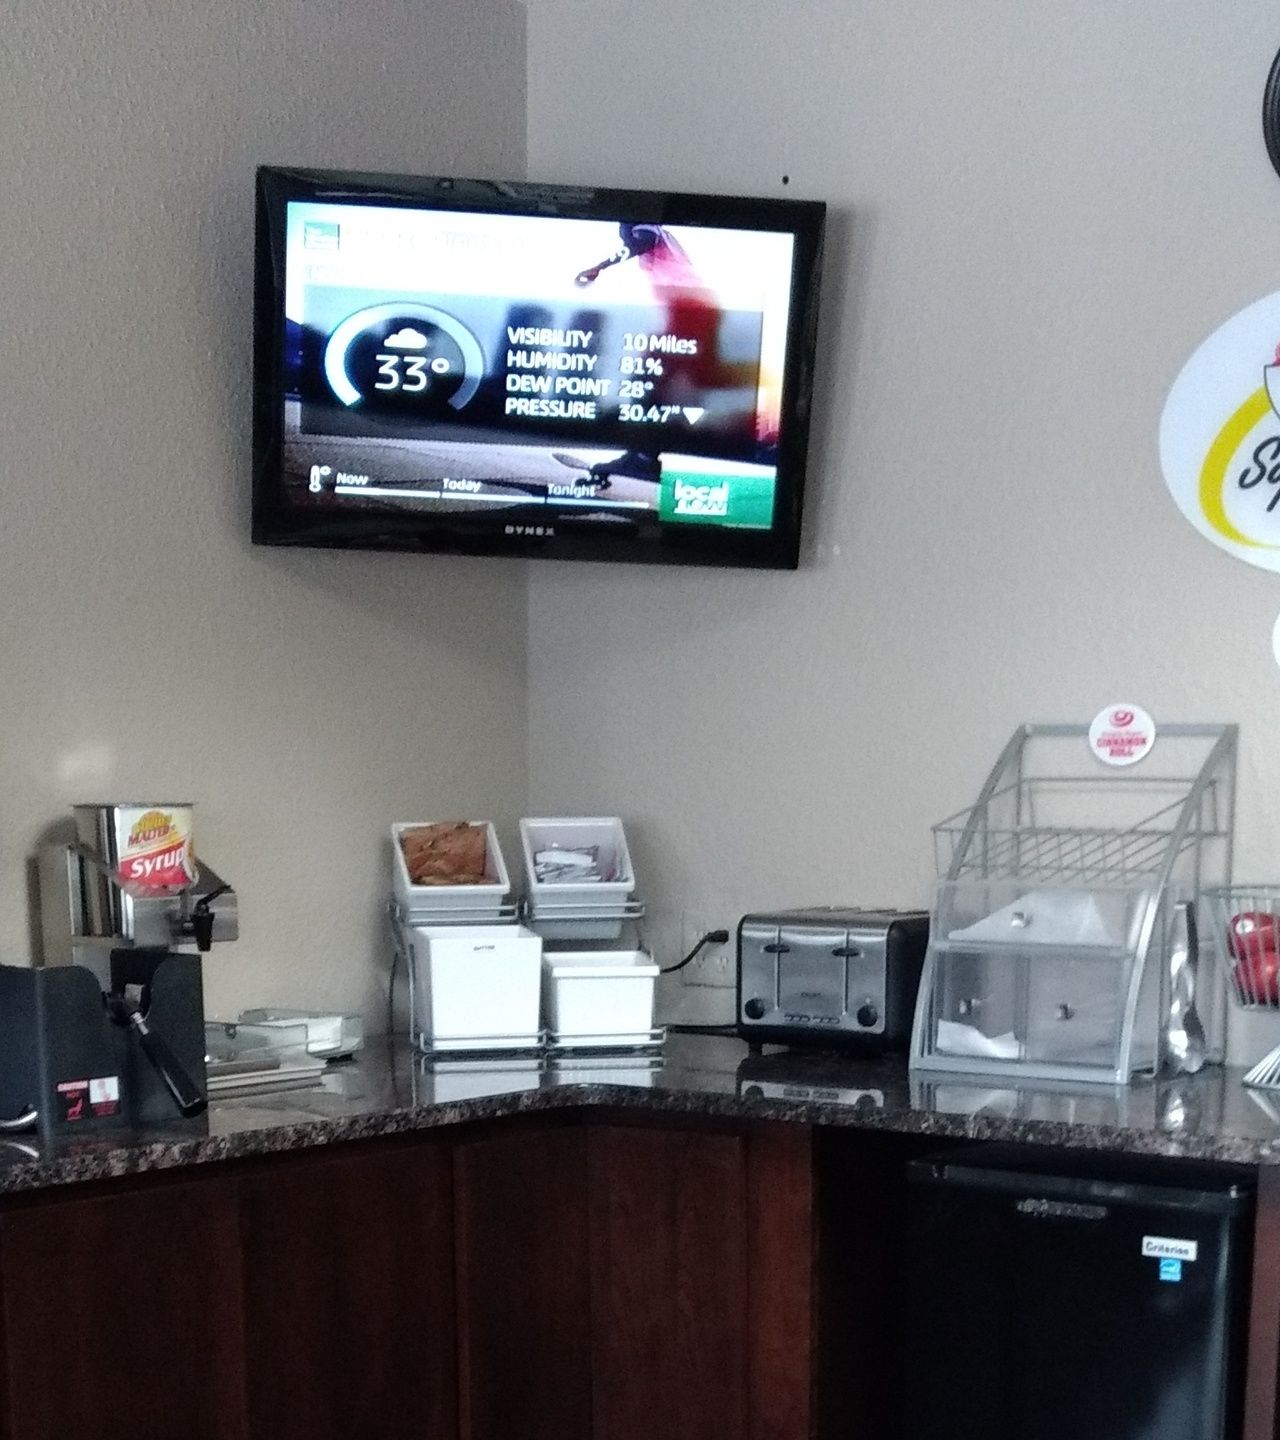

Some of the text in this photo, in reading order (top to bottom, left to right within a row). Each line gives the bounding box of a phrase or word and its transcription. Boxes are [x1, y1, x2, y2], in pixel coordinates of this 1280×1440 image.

[507, 326, 698, 355] VISIBILITY 10 Miles
[507, 350, 664, 376] HUMIDITY 81%
[506, 374, 552, 393] DEW
[555, 376, 611, 396] POINT
[505, 397, 596, 419] PRESSURE
[336, 472, 596, 498] Now Today Tonight
[675, 480, 729, 501] local
[130, 849, 185, 879] Syrup
